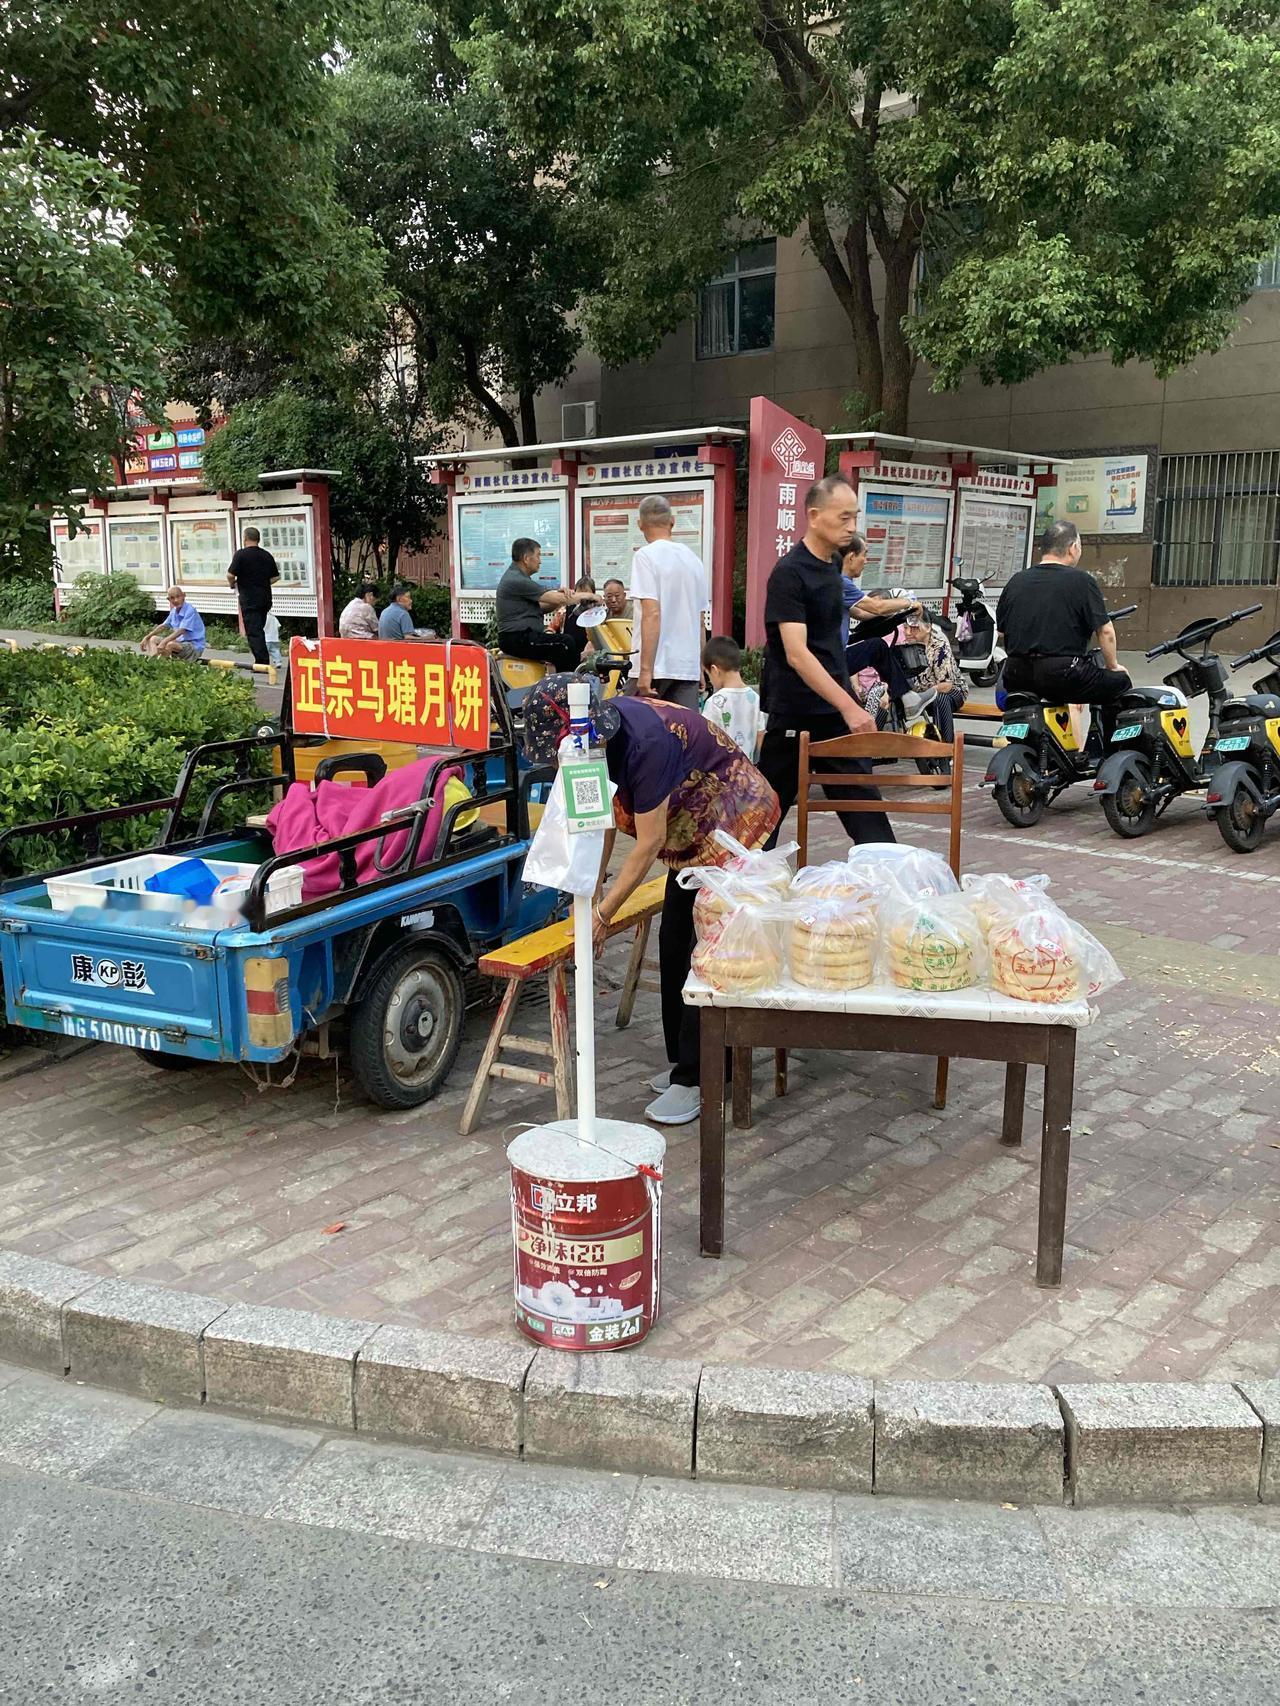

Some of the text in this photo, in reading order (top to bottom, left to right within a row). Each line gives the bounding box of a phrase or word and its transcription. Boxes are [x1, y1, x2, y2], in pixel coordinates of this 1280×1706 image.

[600, 461, 704, 479] 雨顺社区法治宣传栏
[474, 473, 560, 488] 雨顺社区法治宣传栏
[296, 655, 483, 732] 正宗马塘月饼
[99, 965, 117, 977] KP
[90, 1019, 161, 1052] 500070
[555, 1193, 598, 1213] 立邦
